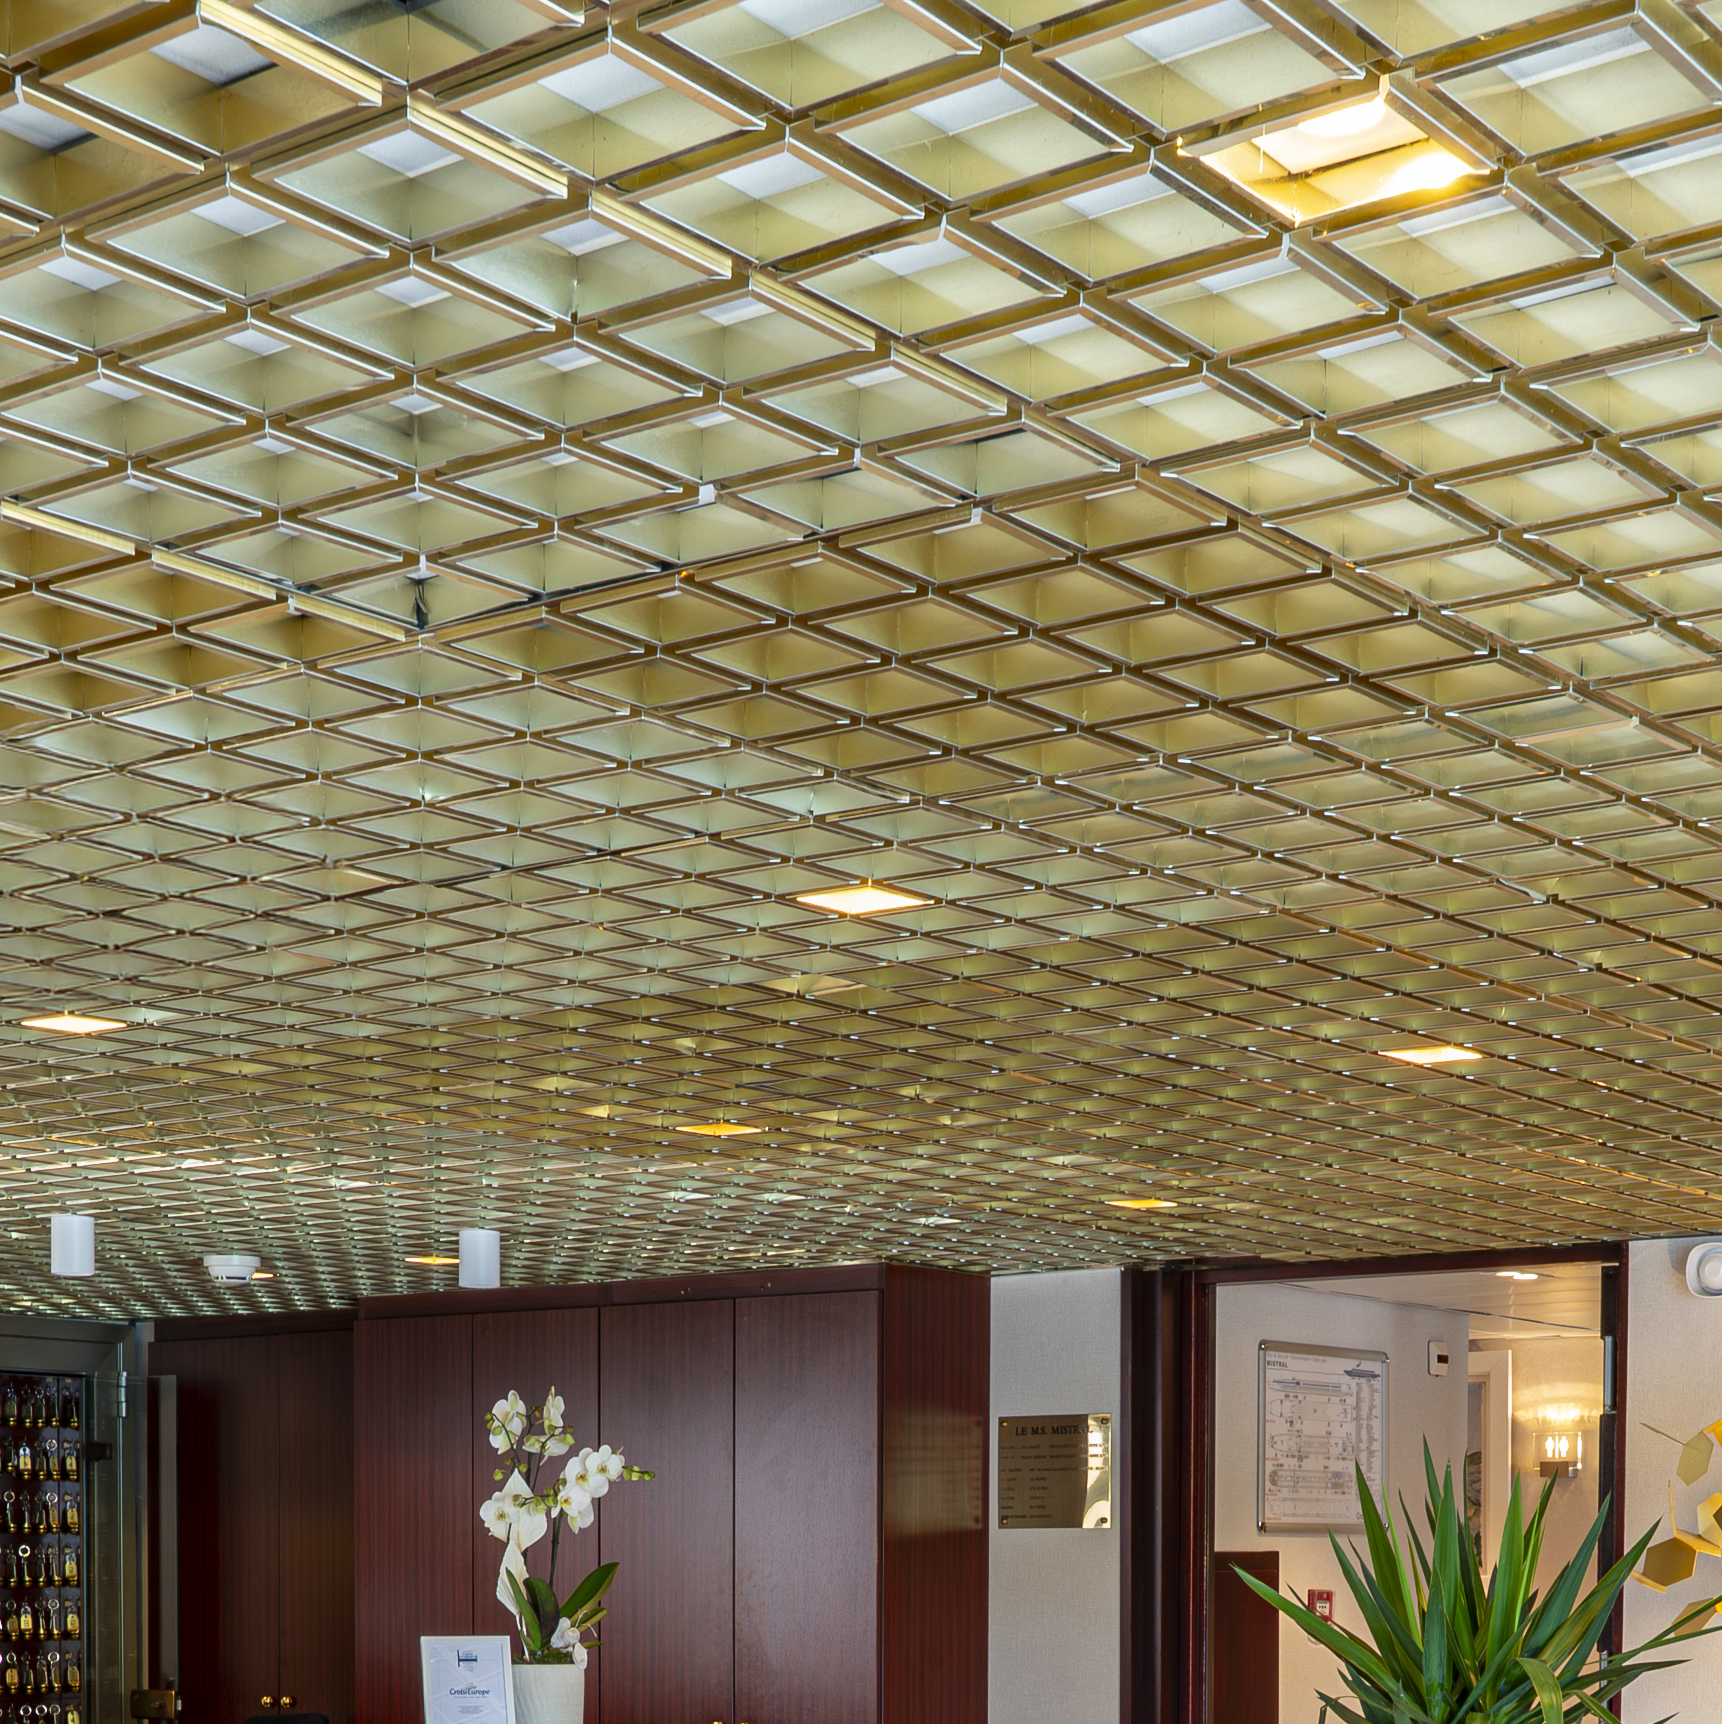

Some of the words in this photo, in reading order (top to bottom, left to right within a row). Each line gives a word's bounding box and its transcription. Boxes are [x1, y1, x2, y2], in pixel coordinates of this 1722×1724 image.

[1267, 1360, 1288, 1368] MISTRAL
[1015, 1426, 1027, 1436] LE
[1051, 1425, 1094, 1435] MISTRAL
[449, 1687, 490, 1696] CroisiEurope
